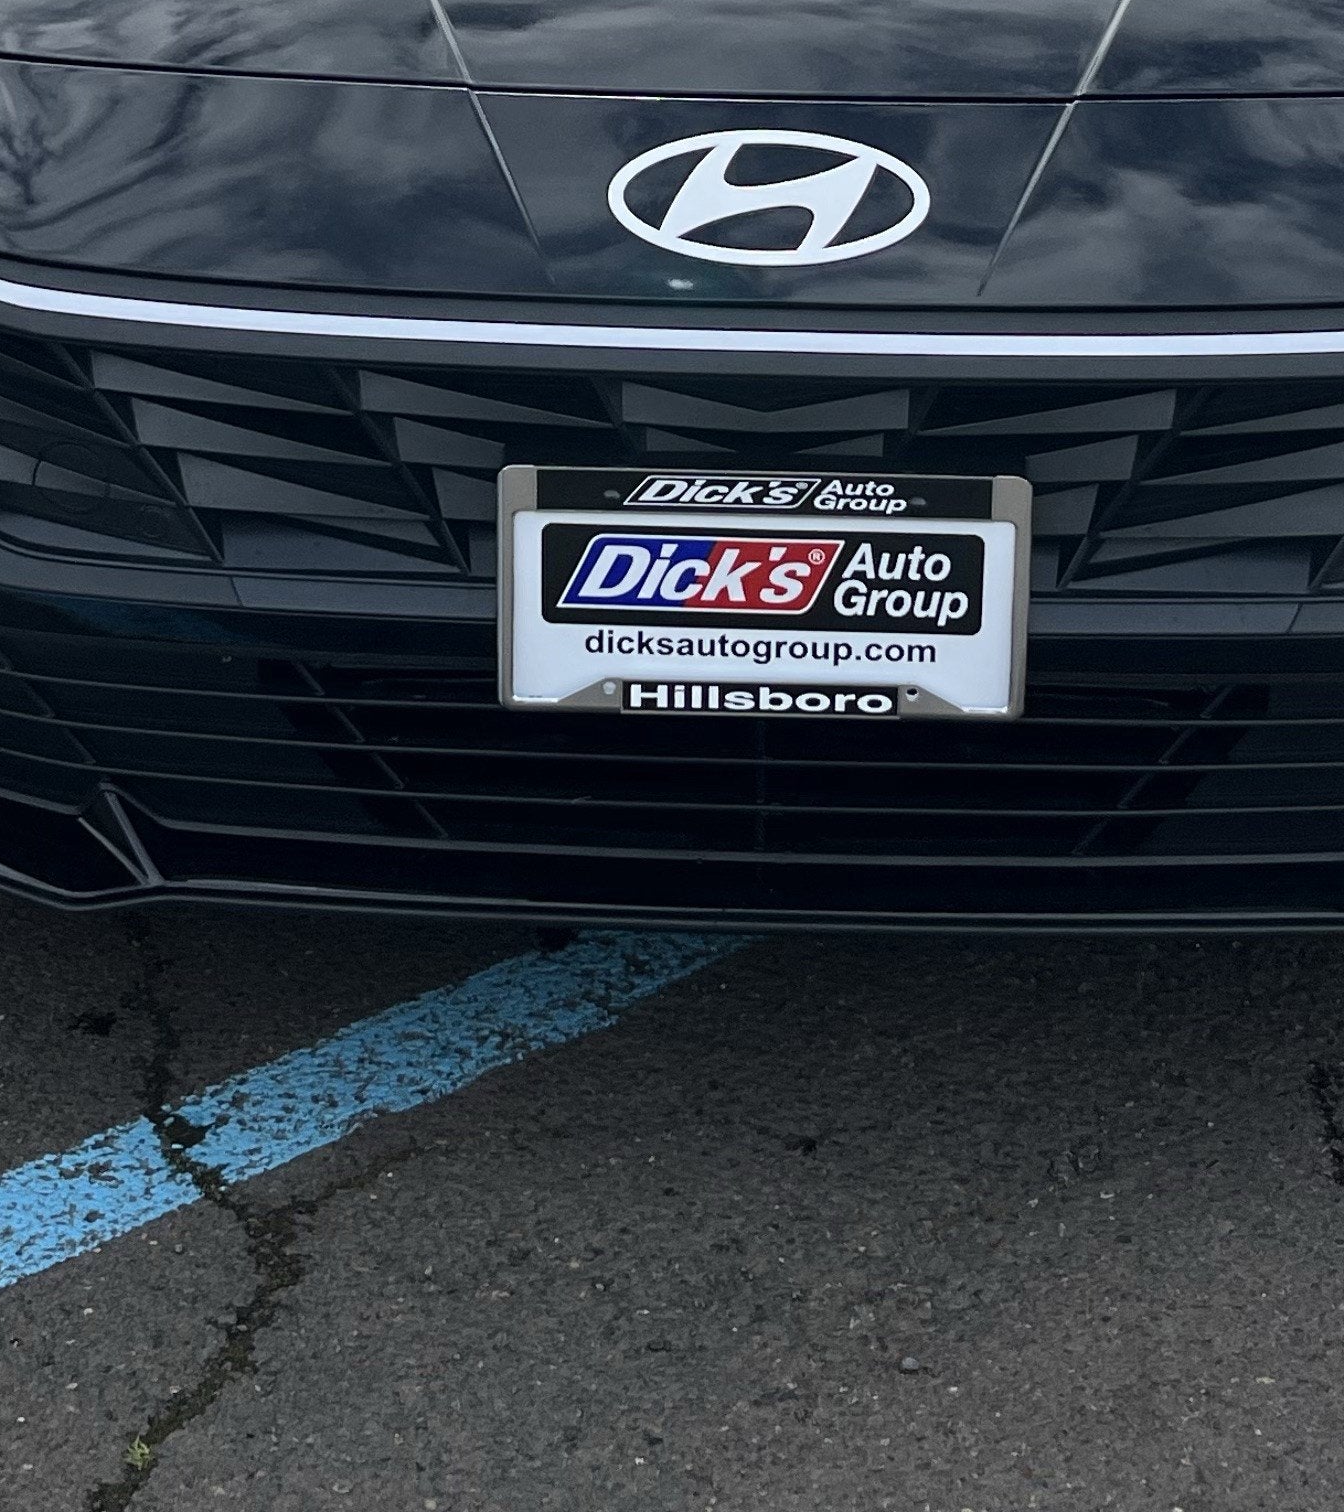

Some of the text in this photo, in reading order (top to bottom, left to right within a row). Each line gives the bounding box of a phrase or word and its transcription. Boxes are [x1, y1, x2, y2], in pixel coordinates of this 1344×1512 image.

[636, 478, 896, 506] Dick's Auto
[812, 493, 908, 515] Group
[577, 542, 953, 605] Dick's Auto
[832, 580, 970, 627] Group
[584, 629, 938, 666] dicksautogroup.com
[629, 684, 894, 715] Hillsboro
